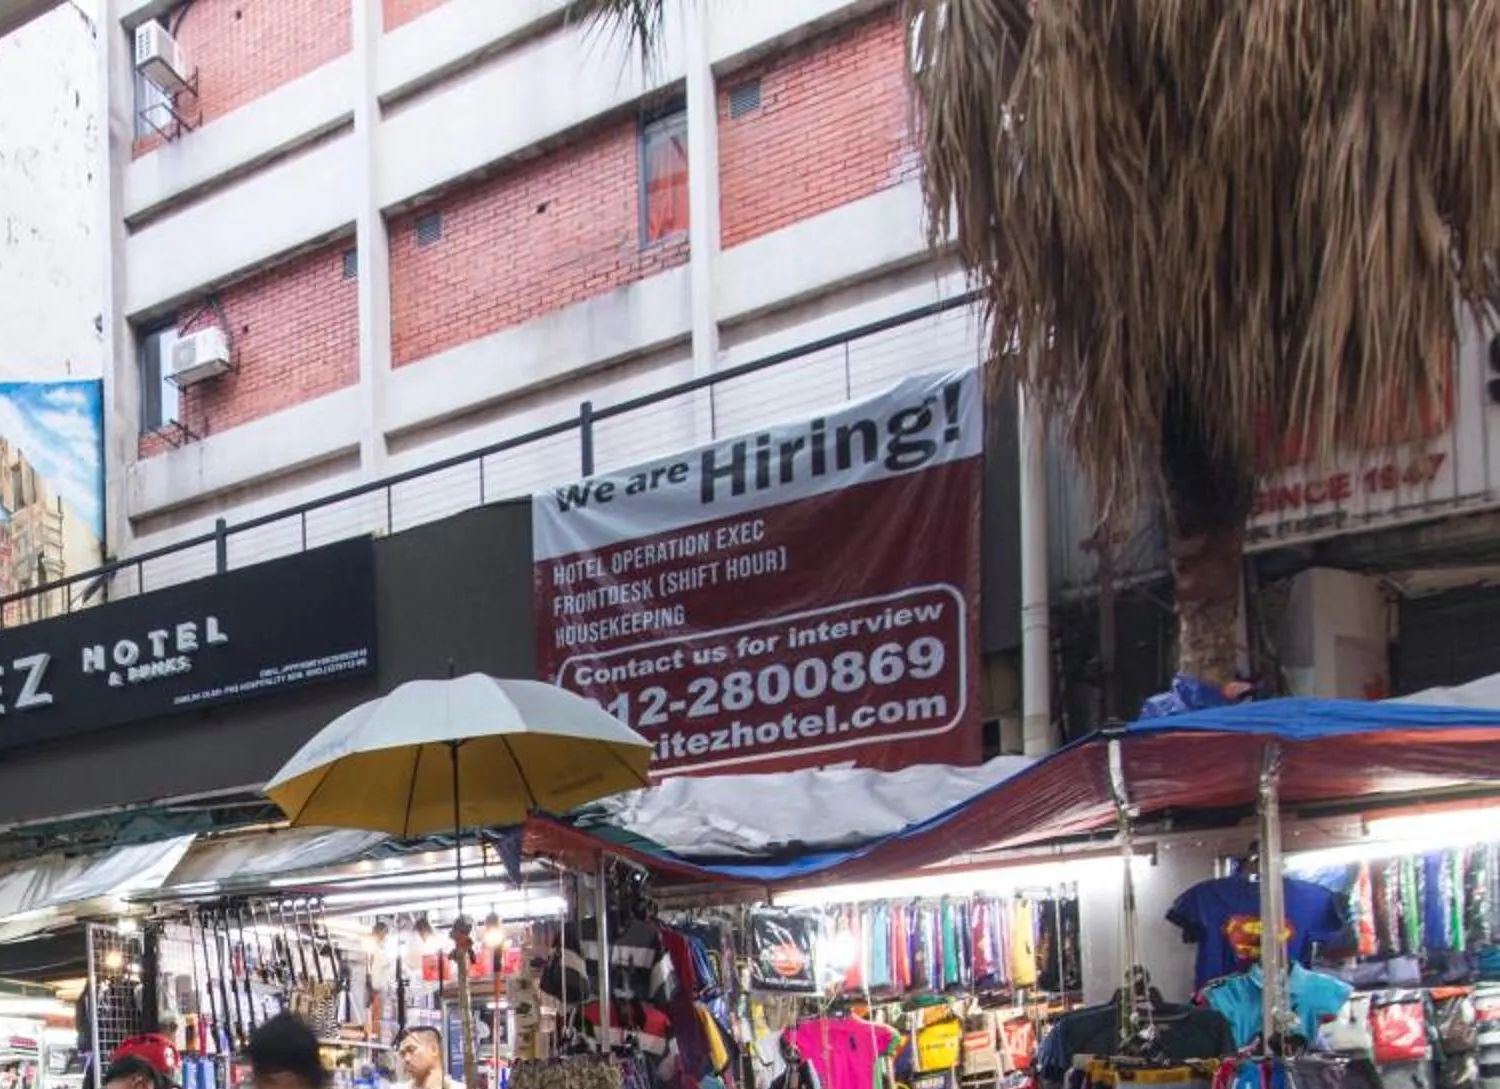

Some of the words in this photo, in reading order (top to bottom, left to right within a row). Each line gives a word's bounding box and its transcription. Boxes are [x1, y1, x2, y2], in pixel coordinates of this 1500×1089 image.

[556, 481, 615, 513] We
[625, 461, 690, 496] are
[700, 382, 963, 504] Hiring!
[553, 558, 606, 586] HOTEL
[611, 532, 710, 575] OPERATION
[716, 519, 765, 549] EXEC
[553, 578, 654, 617] FRONTDESK
[659, 562, 720, 597] (SHIFT
[726, 546, 787, 581] HOUR)
[82, 615, 229, 674] HOTEL
[555, 604, 685, 649] HOUSEKEEPING
[574, 650, 685, 686] Contact
[692, 645, 727, 666] us
[737, 635, 781, 658] for
[788, 601, 944, 648] interview
[108, 671, 124, 687] &
[602, 636, 946, 728] 12-2800869
